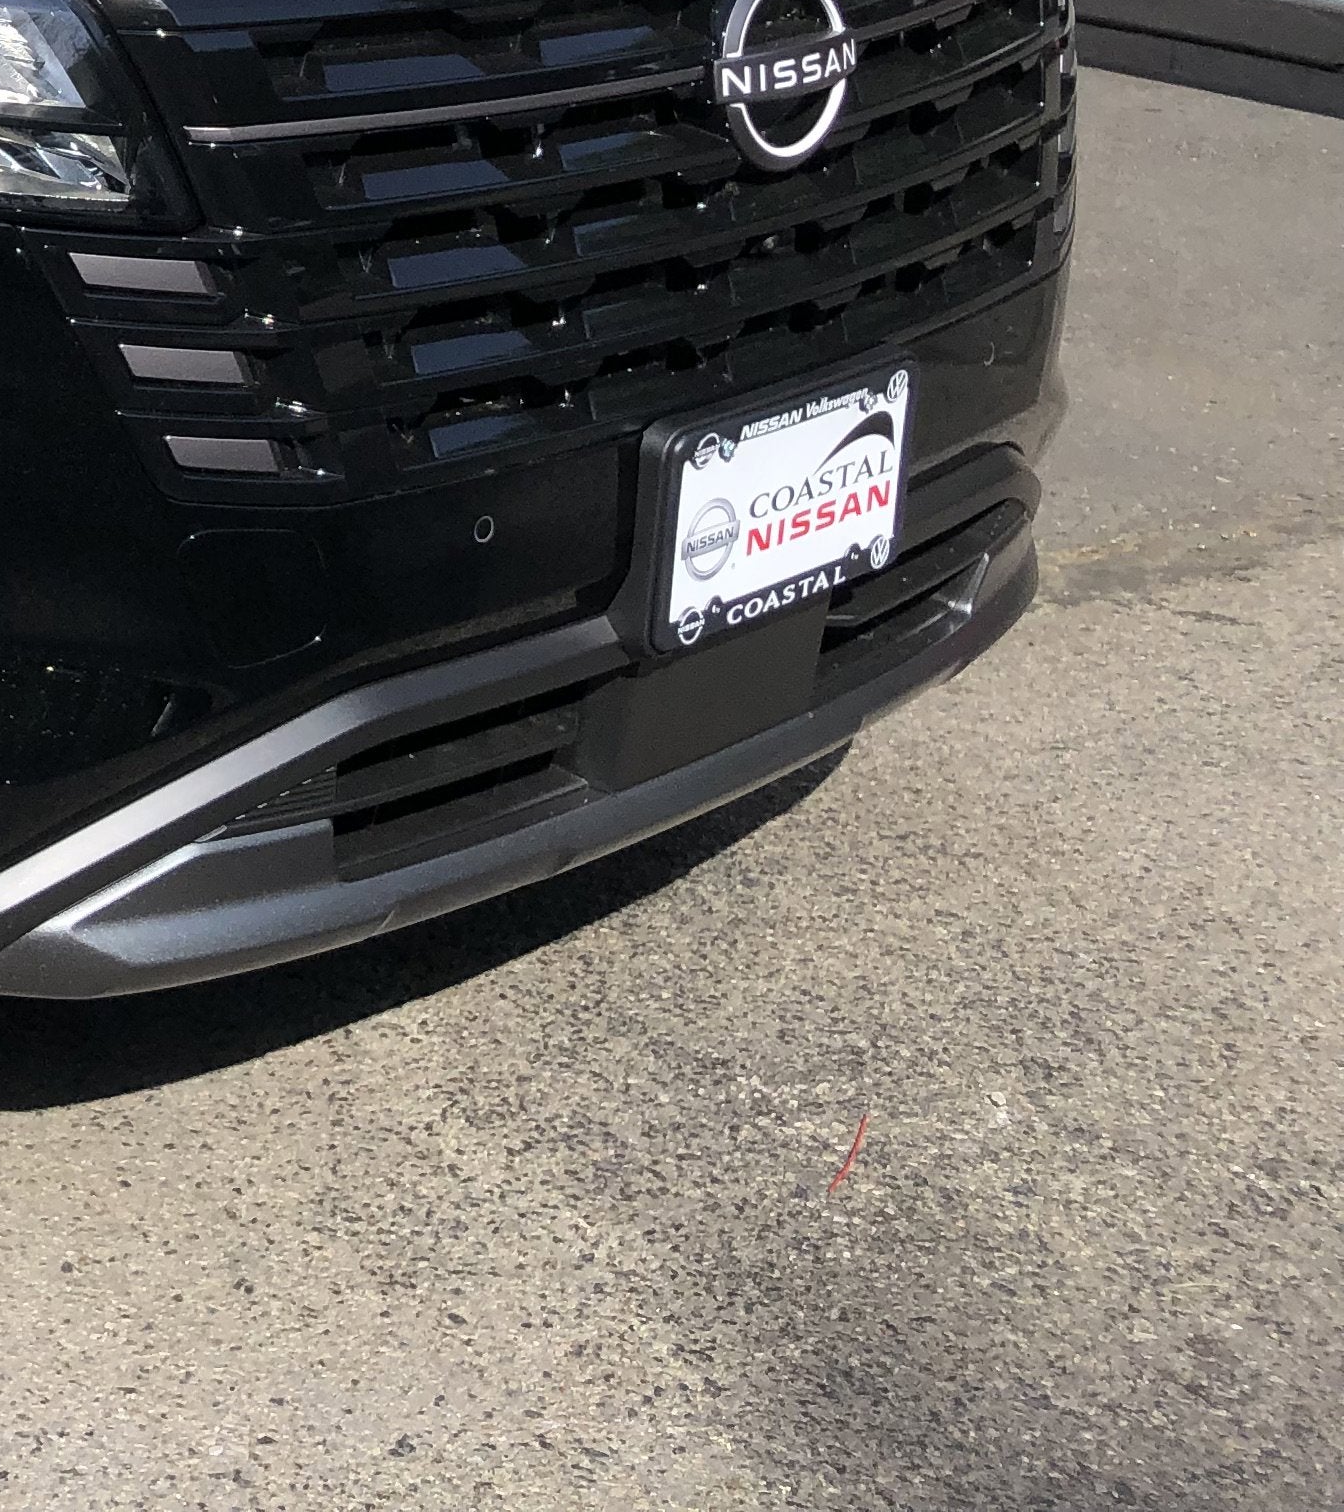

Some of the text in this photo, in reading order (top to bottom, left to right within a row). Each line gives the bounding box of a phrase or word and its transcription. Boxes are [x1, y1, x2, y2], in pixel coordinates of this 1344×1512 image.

[721, 38, 856, 97] NISSAN
[740, 407, 804, 441] NISSAN
[749, 449, 893, 519] COASTAL
[685, 525, 736, 554] NISSAN
[746, 480, 891, 556] NISSAN
[726, 565, 847, 626] COASTAL
